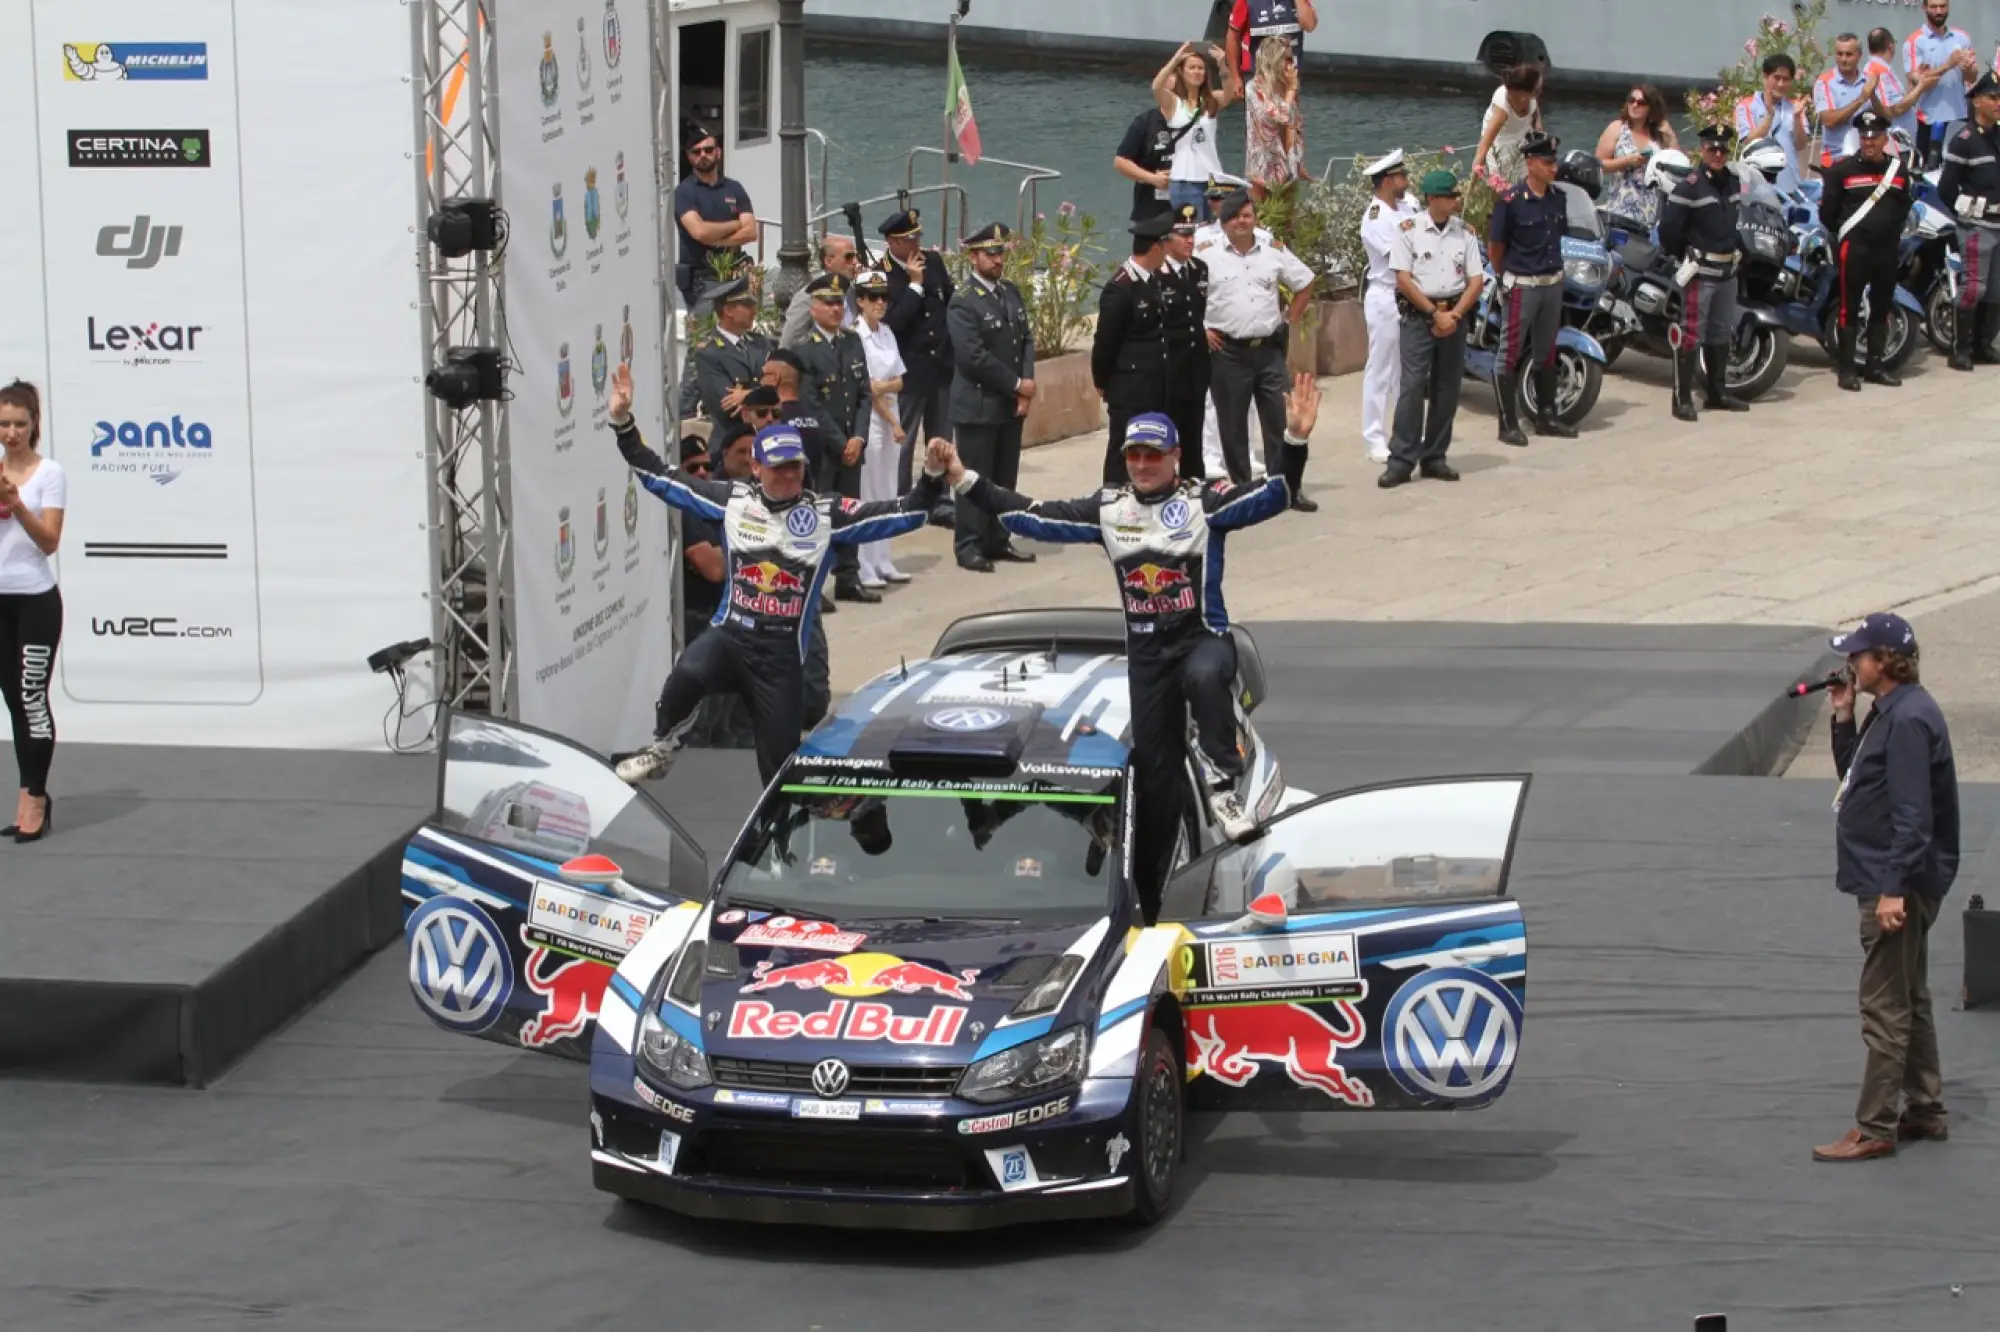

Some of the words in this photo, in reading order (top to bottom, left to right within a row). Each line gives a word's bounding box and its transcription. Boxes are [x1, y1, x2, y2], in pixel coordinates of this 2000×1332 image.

[125, 54, 206, 66] MICHELIN
[75, 138, 179, 151] CERTINA
[88, 316, 204, 351] Lexar
[91, 415, 213, 457] panta
[91, 463, 138, 473] RACING
[141, 463, 172, 473] FUEL
[733, 584, 764, 613] Red
[763, 594, 803, 617] Bull
[1125, 593, 1158, 615] Red
[1158, 586, 1196, 614] Bull
[794, 756, 884, 770] Volkswagen
[1019, 760, 1123, 779] Volkswagen
[836, 776, 857, 786] FIA
[861, 777, 898, 787] World
[901, 779, 934, 791] Rally
[936, 779, 1029, 793] Championship
[536, 897, 623, 933] SARDEGNA
[1215, 946, 1239, 982] 2016
[1242, 950, 1350, 969] SARDEGNA
[1200, 993, 1215, 1002] FIA
[1216, 992, 1239, 1001] World
[1240, 991, 1260, 1001] Rally
[1260, 989, 1315, 1000] Championship
[727, 1000, 850, 1039] Red
[843, 1002, 968, 1046] Bull
[653, 1094, 698, 1123] EDGE
[971, 1115, 1012, 1132] Castrol
[1014, 1096, 1070, 1127] EDGE
